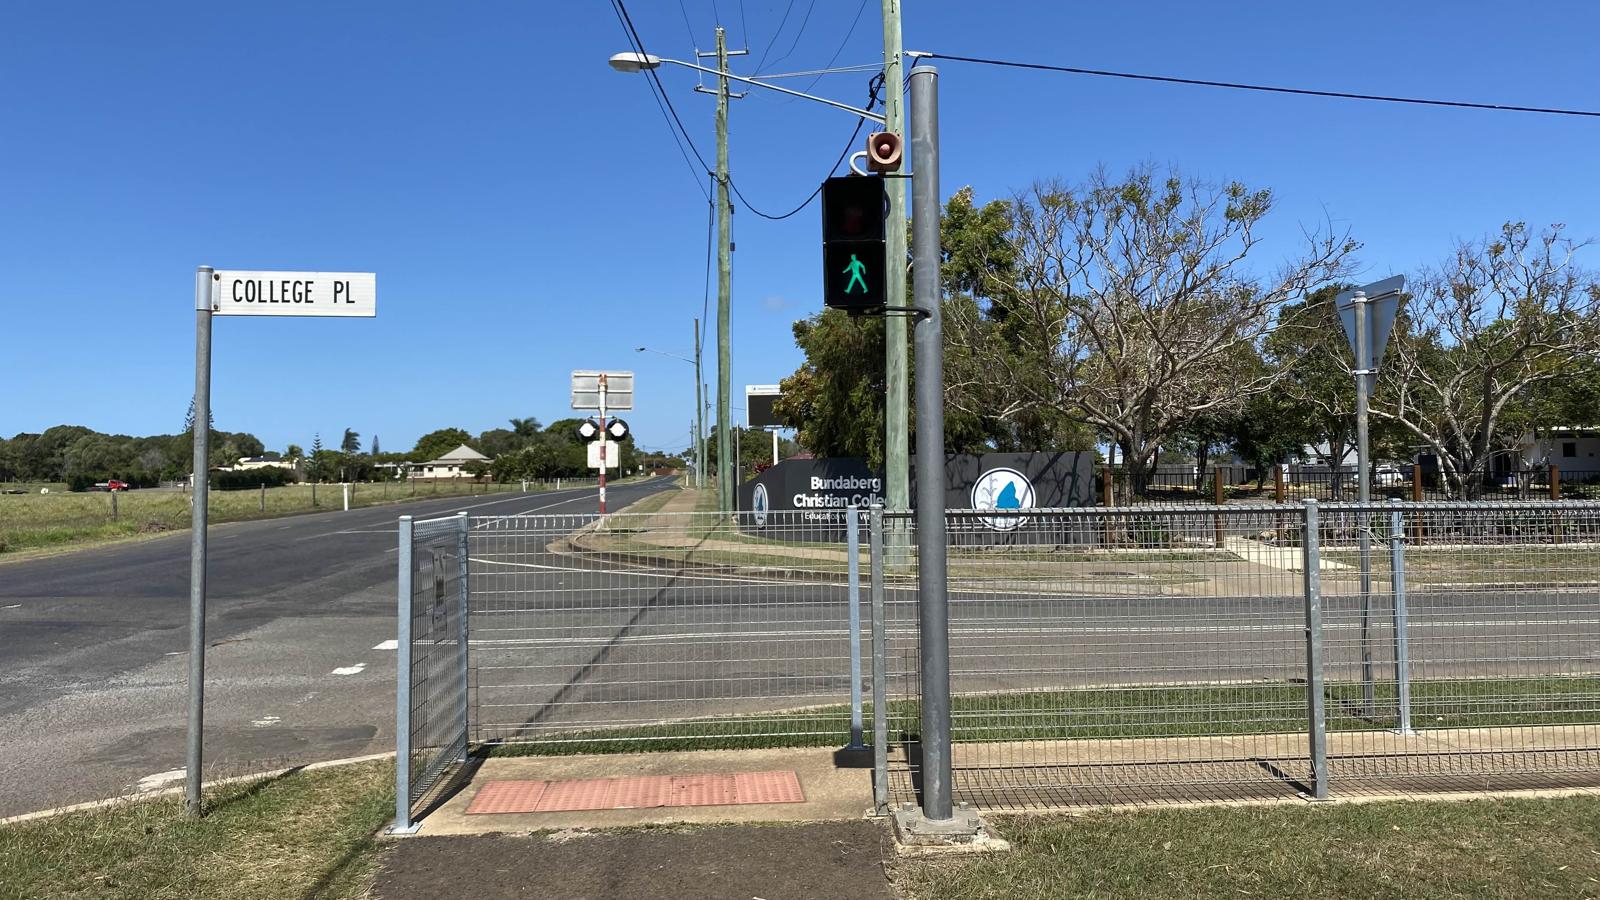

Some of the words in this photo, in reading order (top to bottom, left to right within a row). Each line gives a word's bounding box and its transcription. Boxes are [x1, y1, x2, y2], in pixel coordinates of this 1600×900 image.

[232, 279, 314, 304] COLLEGE
[333, 280, 356, 304] PL
[810, 475, 881, 492] Bundaberg
[793, 493, 848, 508] Christian
[851, 493, 888, 508] Colle
[804, 511, 839, 520] Educaton
